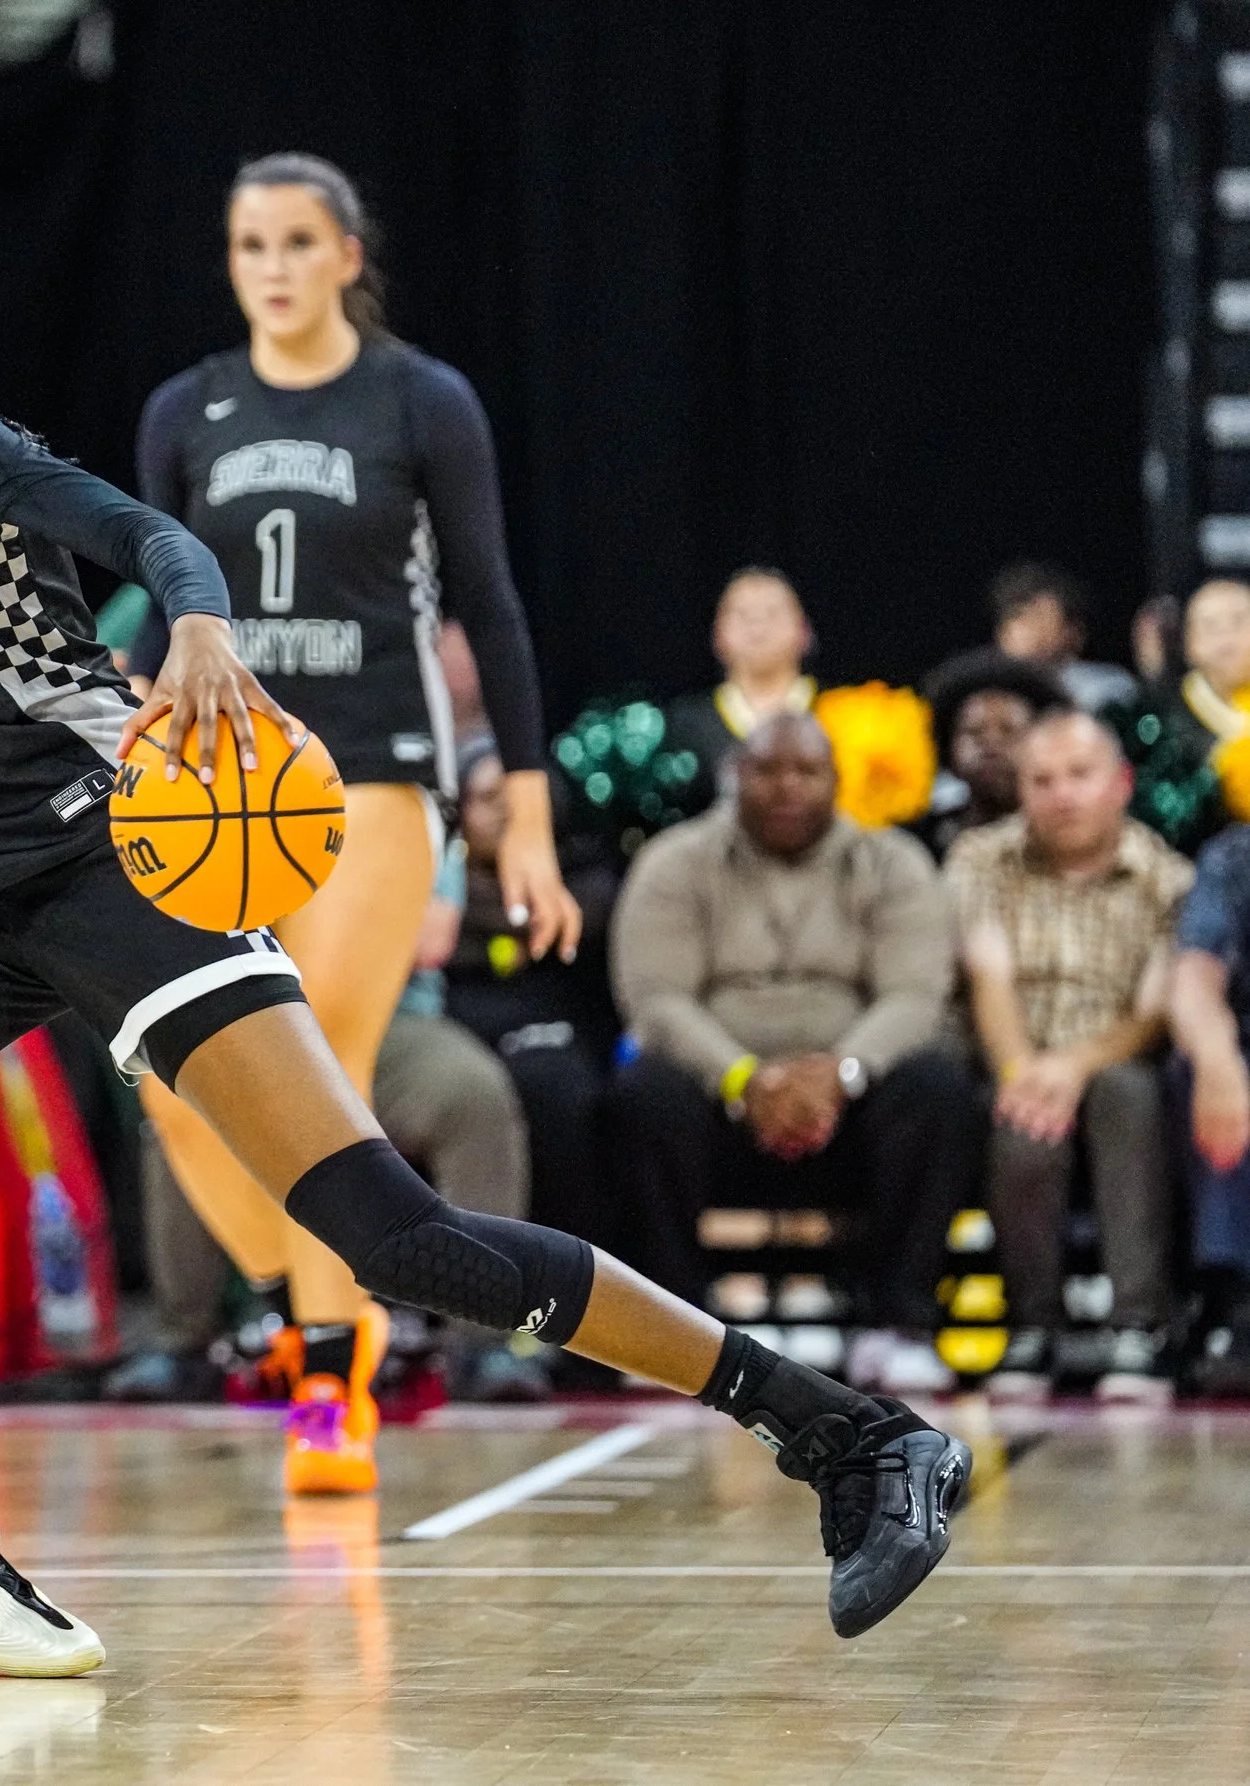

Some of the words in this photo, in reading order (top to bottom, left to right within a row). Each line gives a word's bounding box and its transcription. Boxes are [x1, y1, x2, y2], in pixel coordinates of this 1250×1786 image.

[256, 508, 296, 613] 1
[230, 618, 362, 676] NYON
[92, 779, 106, 791] L
